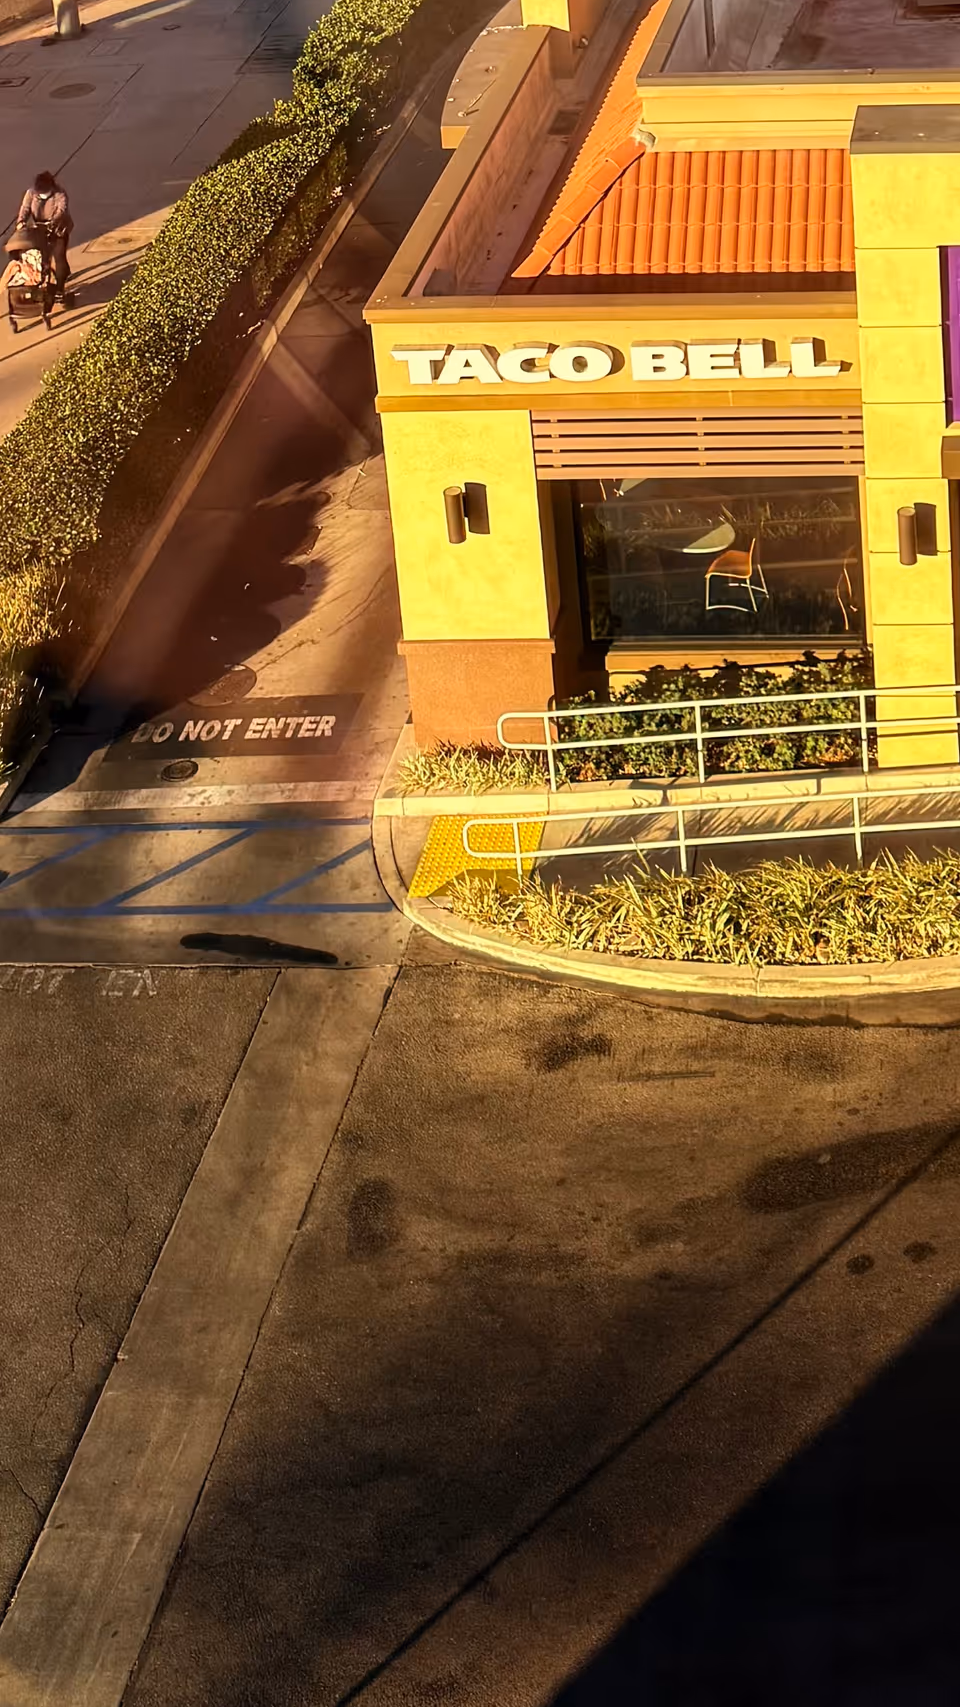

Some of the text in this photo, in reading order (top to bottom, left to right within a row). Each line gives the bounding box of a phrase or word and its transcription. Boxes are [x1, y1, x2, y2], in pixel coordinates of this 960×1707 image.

[390, 338, 847, 385] TACO BELL
[131, 715, 336, 743] DO NOT ENTER
